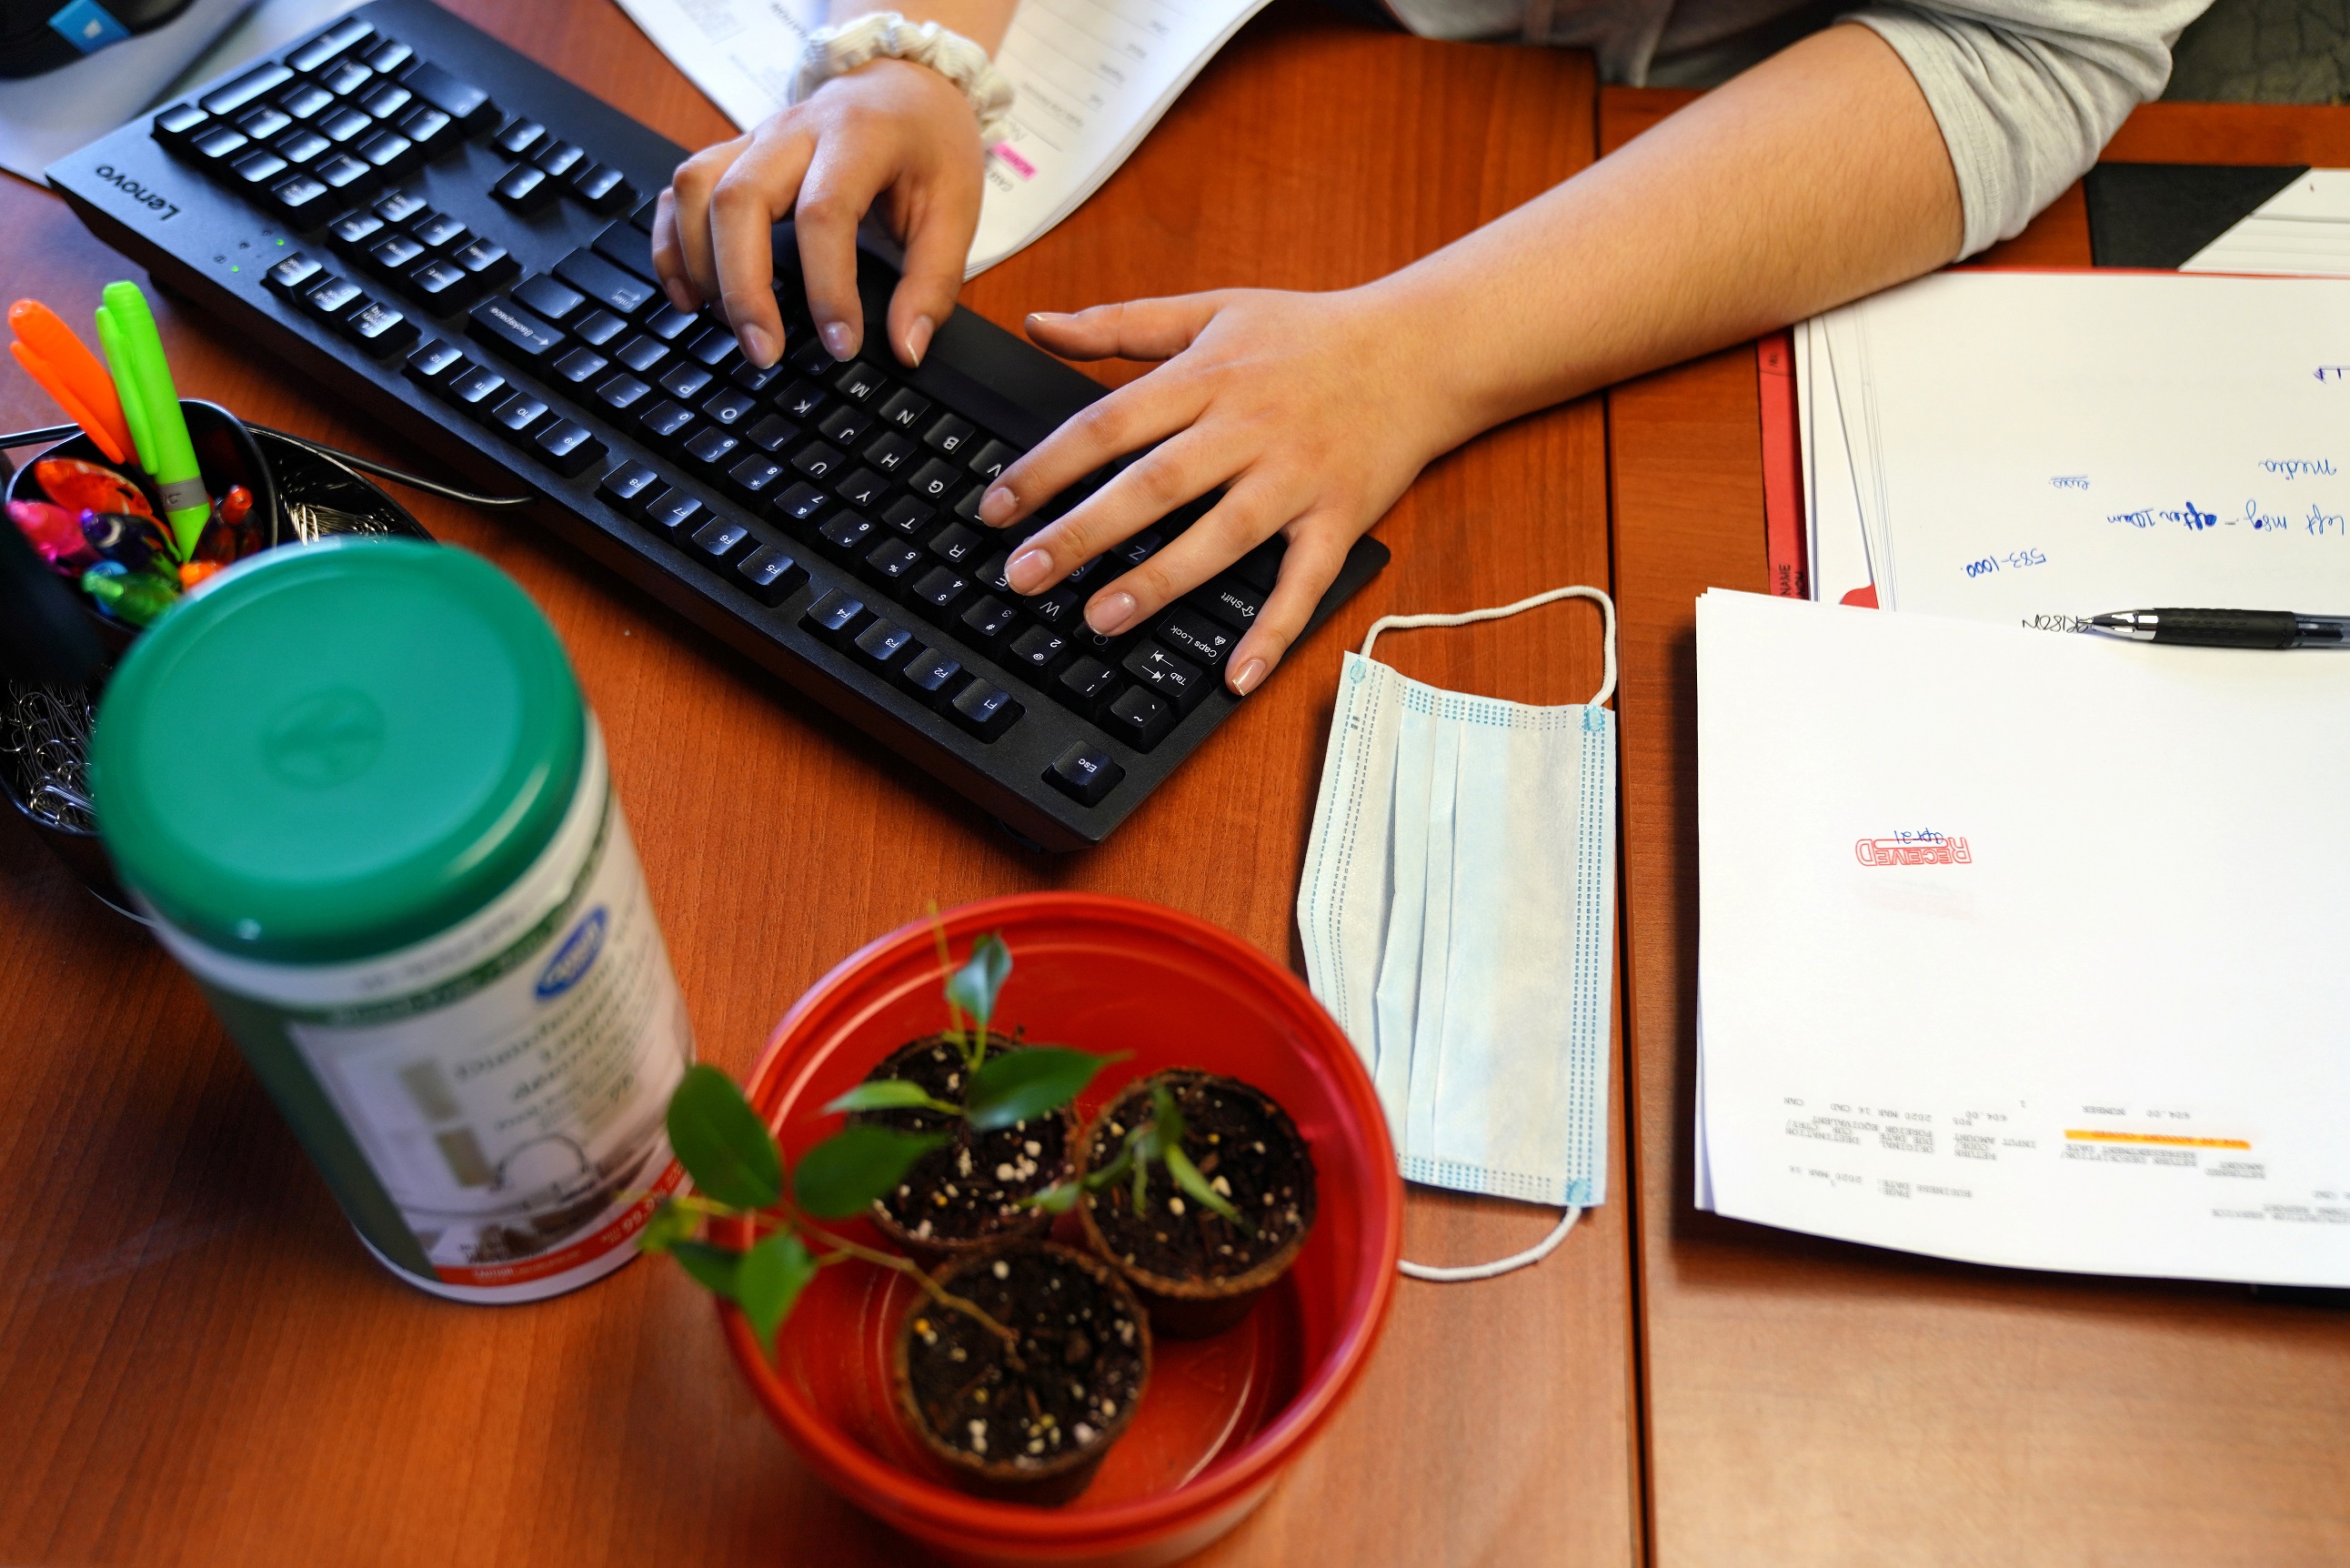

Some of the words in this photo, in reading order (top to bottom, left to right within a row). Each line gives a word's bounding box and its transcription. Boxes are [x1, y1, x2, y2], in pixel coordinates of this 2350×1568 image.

[95, 165, 180, 221] Lenovo
[488, 306, 534, 337] Backspace
[677, 384, 696, 394] P
[849, 381, 870, 397] M
[792, 398, 811, 413] K
[896, 407, 915, 424] N
[839, 427, 854, 438] J
[722, 438, 733, 447] 9
[771, 437, 783, 447] I
[943, 436, 959, 450] B
[879, 452, 899, 467] H
[766, 466, 778, 475] 8
[808, 461, 827, 474] U
[986, 462, 1001, 477] V
[628, 477, 643, 487] F8
[928, 478, 944, 493] G
[810, 495, 823, 503] 7
[855, 490, 870, 502] Y
[672, 507, 688, 517] F7
[859, 523, 869, 531] 6
[900, 517, 915, 528] T
[719, 534, 734, 544] F6
[949, 544, 966, 558] R
[1128, 545, 1146, 560] Z
[765, 563, 780, 574] F5
[952, 579, 962, 588] 4
[1777, 563, 1791, 597] NAME
[1220, 592, 1244, 608] Shift
[836, 608, 850, 618] F4
[1001, 609, 1010, 618] 3
[1039, 600, 1060, 617] W
[1170, 625, 1193, 644] Lock
[885, 637, 899, 648] F3
[1049, 638, 1061, 648] 2
[1193, 639, 1217, 658] Caps
[934, 667, 949, 678] F2
[1101, 670, 1110, 678] 1
[1170, 672, 1187, 686] Tab
[983, 699, 998, 709] F1
[1078, 758, 1098, 772] Esc
[1893, 829, 1912, 844] 21
[1854, 836, 1972, 866] RECEIVED
[1783, 1096, 1803, 1106] CAN
[1830, 1102, 1851, 1112] CAD
[1877, 1108, 1899, 1117] MAR
[2081, 1105, 2126, 1116] NUMBER
[1903, 1111, 1932, 1121] 2020
[1810, 1115, 1878, 1131] EQUIVALENT
[1784, 1127, 1859, 1143] DESTINATION
[1832, 1126, 1851, 1134] CUR
[1883, 1125, 1932, 1136] FOREIGN
[1878, 1131, 1905, 1141] DATE
[1912, 1135, 1933, 1143] DUE
[1952, 1132, 1994, 1142] AMOUNT
[1878, 1139, 1933, 1152] ORIGINAL
[2001, 1137, 2036, 1148] INPUT
[2064, 1143, 2094, 1152] DATE
[1953, 1149, 1996, 1160] RETURN
[1808, 1167, 1829, 1178] MAR
[1834, 1171, 1863, 1183] 2020
[1877, 1178, 1911, 1189] DATE:
[1877, 1185, 1911, 1198] PAGE:
[1915, 1184, 1972, 1198] BUSINESS
